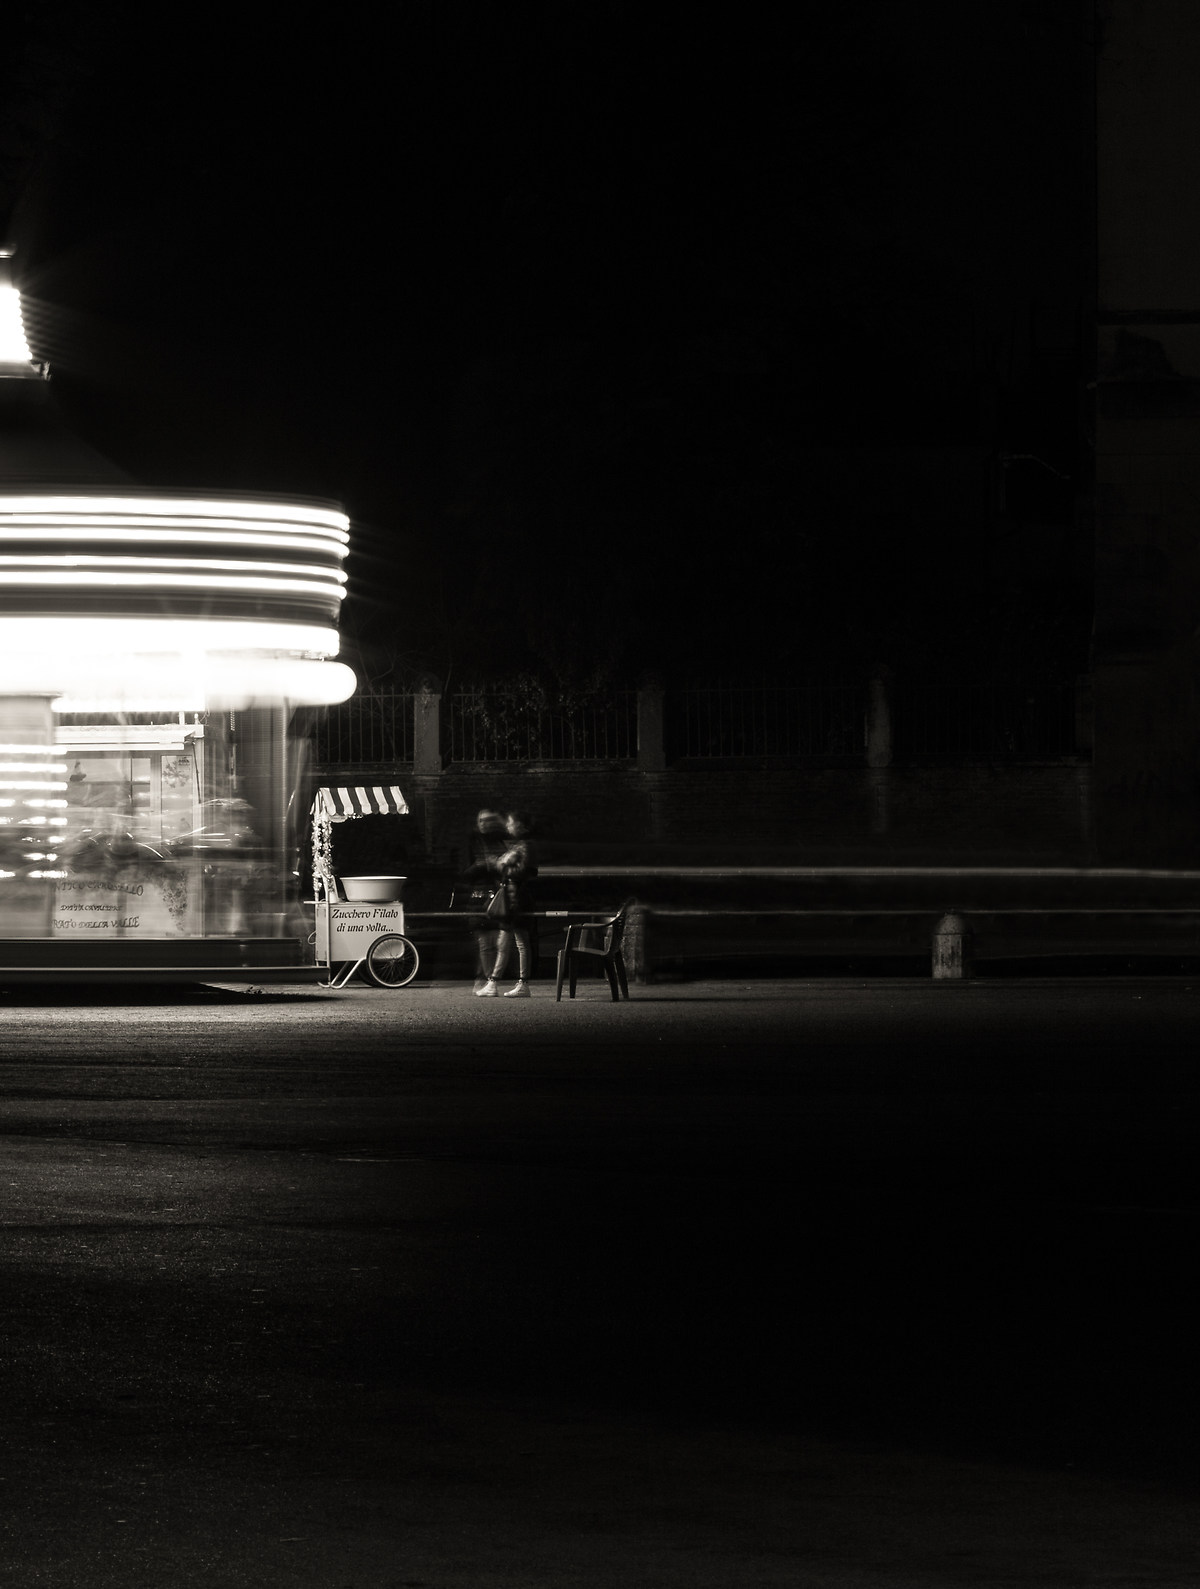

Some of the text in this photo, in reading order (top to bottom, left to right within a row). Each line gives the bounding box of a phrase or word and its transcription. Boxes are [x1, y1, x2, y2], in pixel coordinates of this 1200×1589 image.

[331, 908, 399, 919] Zucchero Filato
[52, 916, 140, 929] RATO DELLA VALLE
[336, 922, 347, 932] di
[347, 924, 364, 932] una
